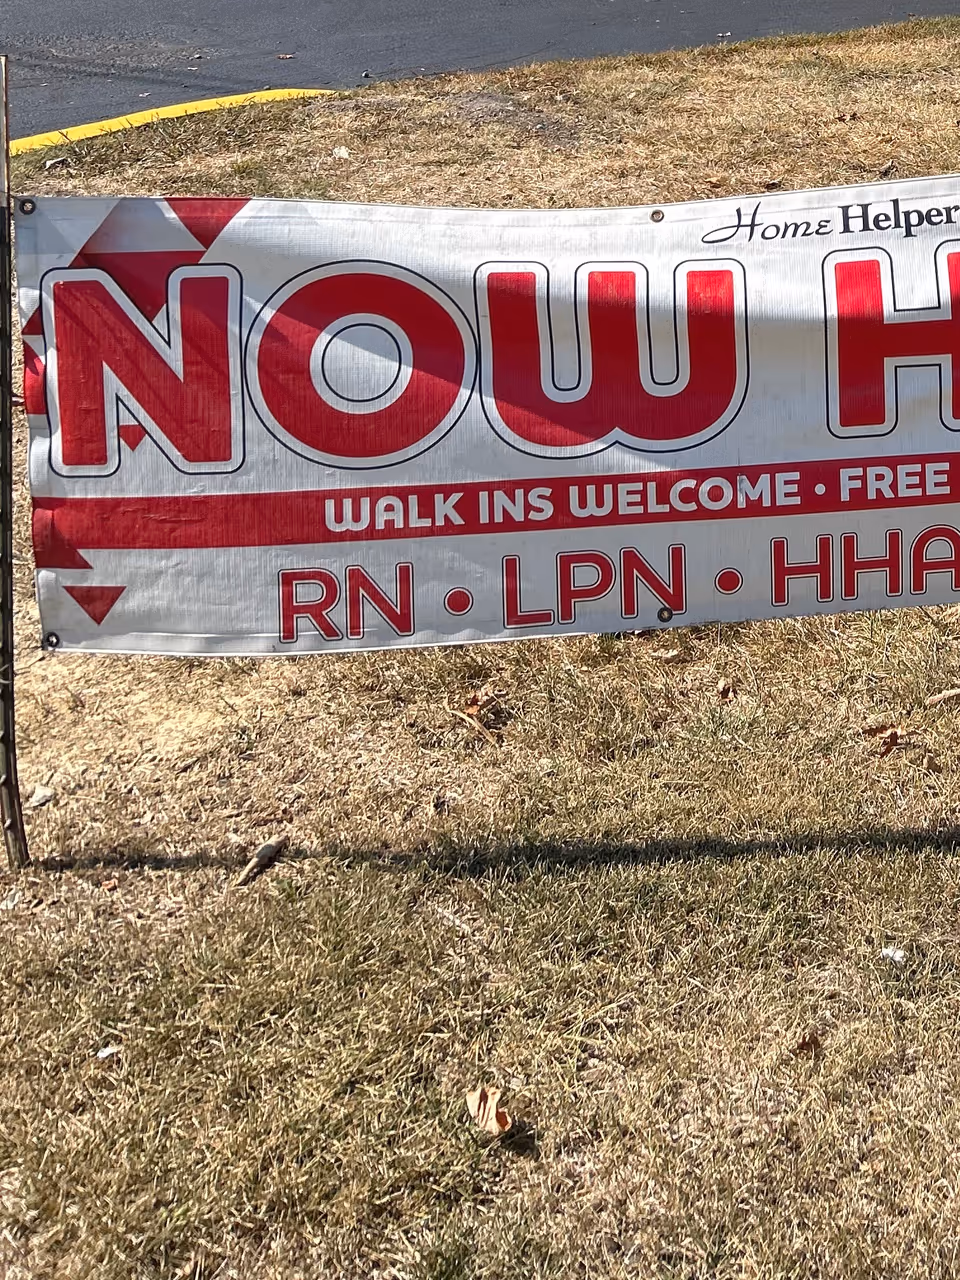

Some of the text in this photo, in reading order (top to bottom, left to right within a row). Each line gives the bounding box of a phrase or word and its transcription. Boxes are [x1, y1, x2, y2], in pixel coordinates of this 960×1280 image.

[701, 200, 834, 245] Home
[40, 259, 751, 477] NOW
[324, 492, 466, 533] WALK
[478, 486, 555, 524] INS
[568, 471, 802, 519] WELCOME
[839, 462, 951, 502] FREE
[277, 560, 416, 643] RN
[501, 542, 688, 630] LPN
